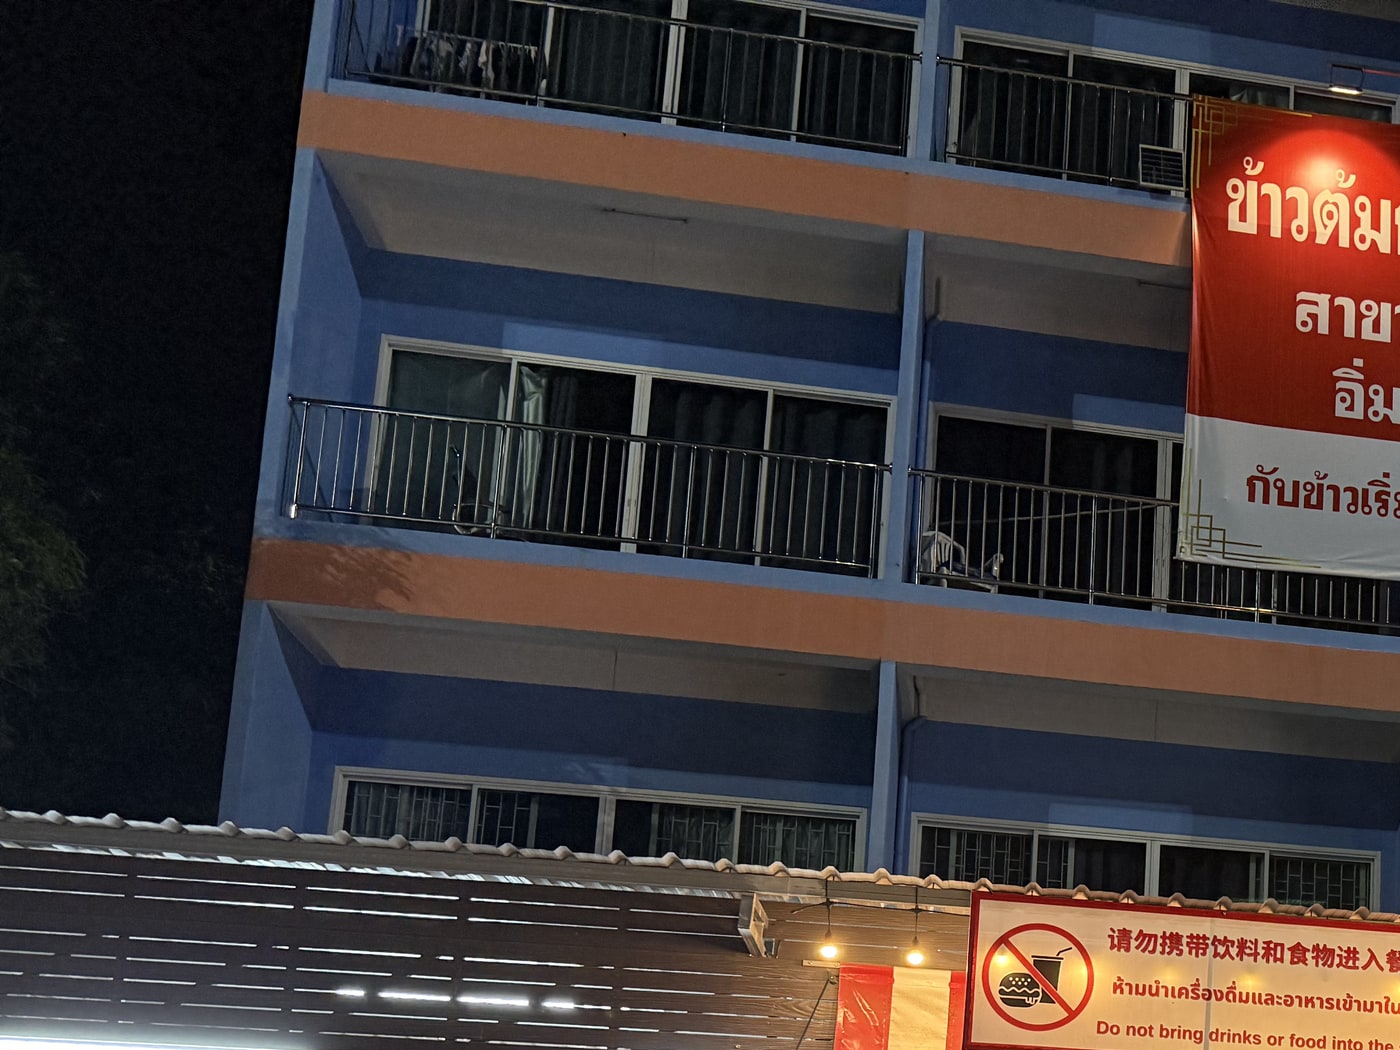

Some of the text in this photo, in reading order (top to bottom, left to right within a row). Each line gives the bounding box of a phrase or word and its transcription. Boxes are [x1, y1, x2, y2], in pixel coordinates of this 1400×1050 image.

[1096, 1020, 1121, 1036] Do
[1125, 1024, 1154, 1038] not
[1159, 1023, 1204, 1045] bring
[1208, 1027, 1262, 1045] drinks
[1266, 1034, 1285, 1047] or
[1289, 1033, 1327, 1050] food
